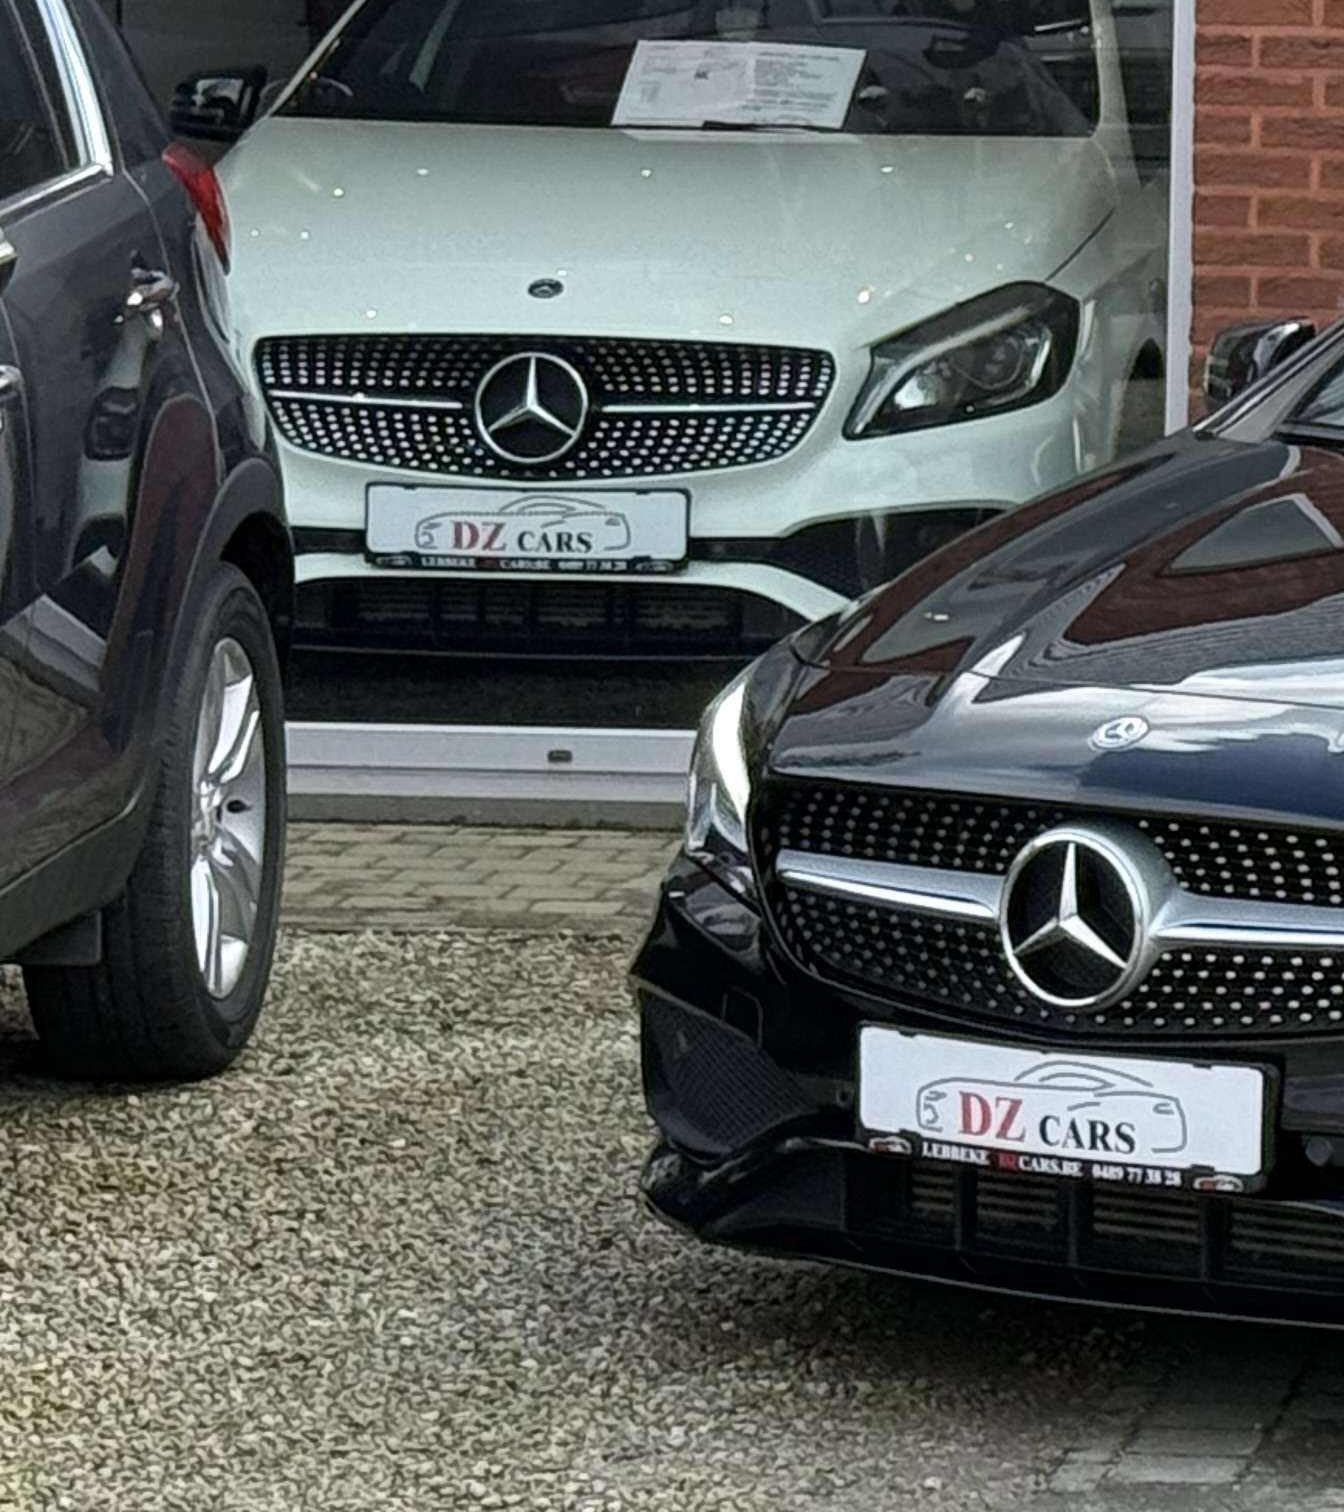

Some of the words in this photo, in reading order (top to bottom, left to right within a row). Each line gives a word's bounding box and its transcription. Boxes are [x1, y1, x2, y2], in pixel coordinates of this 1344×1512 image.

[453, 521, 507, 551] DZ
[518, 531, 592, 553] CARS
[957, 1090, 1026, 1143] DZ
[1038, 1115, 1135, 1155] CARS
